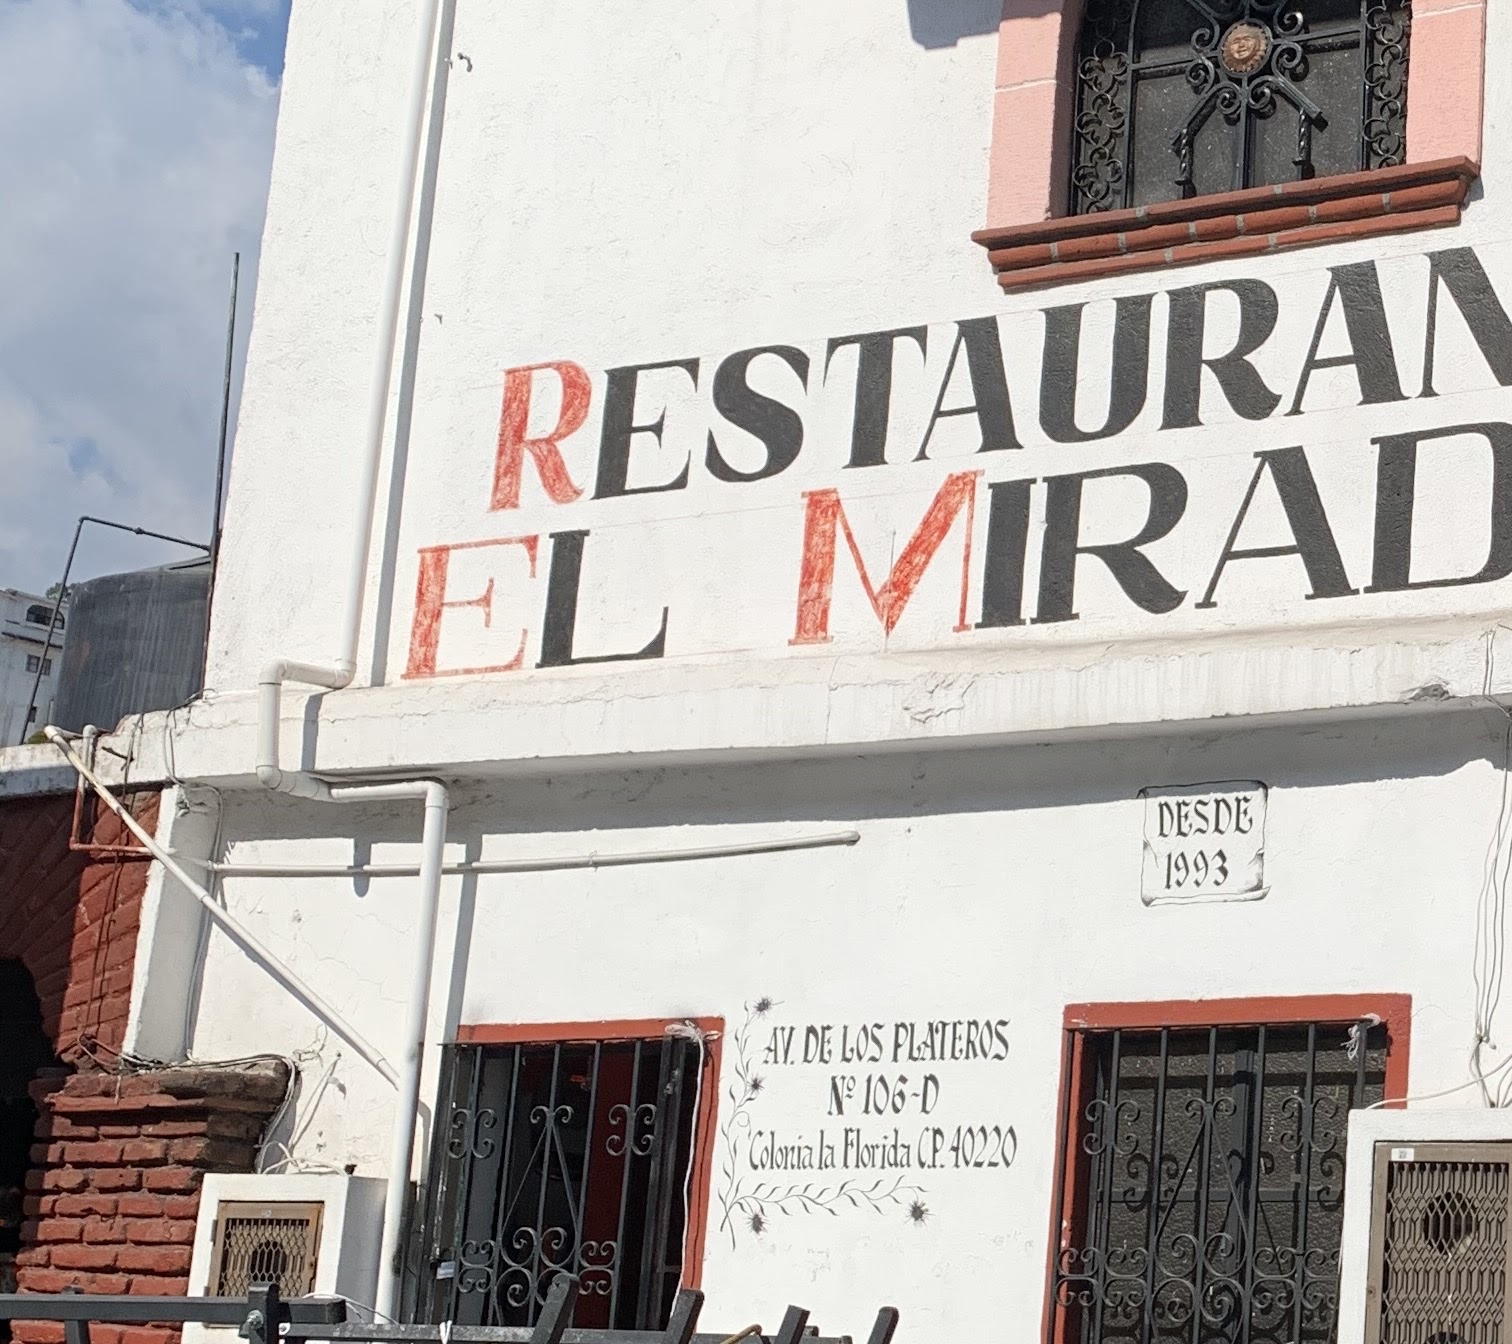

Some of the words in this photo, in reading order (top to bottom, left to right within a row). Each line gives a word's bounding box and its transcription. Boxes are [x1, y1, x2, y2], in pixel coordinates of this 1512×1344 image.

[402, 529, 669, 678] EL
[1158, 795, 1253, 838] DESDE
[1165, 848, 1229, 890] 1993
[762, 1026, 795, 1065] AV.
[802, 1024, 833, 1064] DE
[840, 1023, 885, 1063] LOS
[891, 1019, 1011, 1063] PLATEROS
[862, 1073, 940, 1115] 106-D
[749, 1130, 814, 1170] Colonia
[817, 1128, 835, 1170] la
[841, 1127, 911, 1170] Florida
[948, 1125, 1017, 1169] 40220
